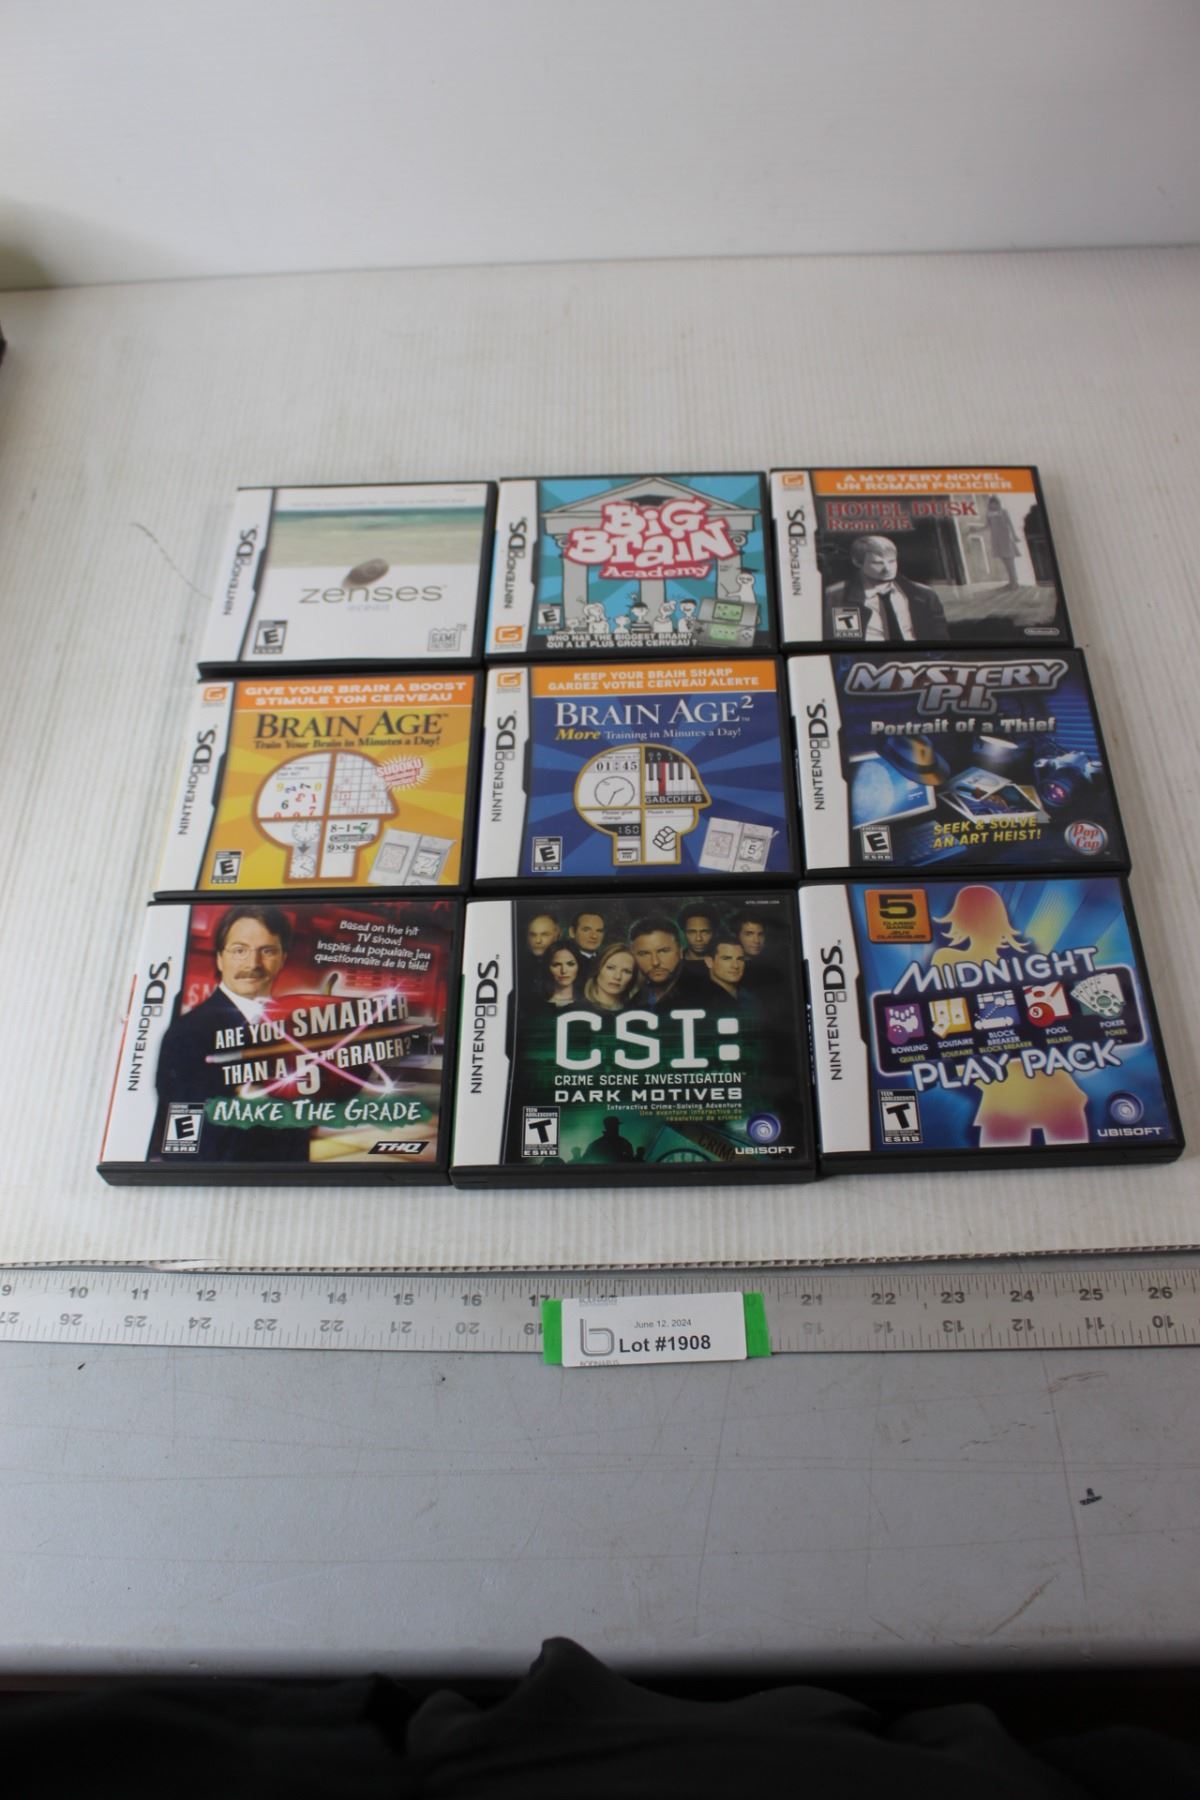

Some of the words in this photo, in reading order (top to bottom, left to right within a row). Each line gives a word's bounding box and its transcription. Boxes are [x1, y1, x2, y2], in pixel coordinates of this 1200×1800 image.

[858, 473, 941, 482] MYSTERY
[946, 473, 1003, 481] NOVEL
[866, 482, 928, 490] ROMAN
[932, 481, 1012, 489] POLICIER
[826, 501, 908, 517] HOTEL
[912, 500, 978, 516] DUSK
[787, 509, 806, 537] DS
[827, 518, 877, 530] Room
[882, 518, 912, 530] 215
[508, 521, 527, 550] DS
[604, 565, 710, 578] Academy
[298, 585, 443, 603] zenses
[658, 632, 693, 640] BRAIN?
[589, 640, 614, 648] PLUS
[646, 639, 690, 647] CERVEAU
[574, 672, 607, 681] KEEP
[611, 671, 643, 680] YOUR
[648, 669, 686, 679] BRAIN
[690, 668, 733, 677] SHARP
[851, 663, 1059, 691] MYSTERY
[245, 686, 284, 696] GIVE
[288, 685, 334, 695] YOUR
[338, 684, 390, 693] BRAIN
[393, 683, 405, 692] A
[409, 682, 466, 691] BOOST
[548, 681, 599, 691] GARDEZ
[604, 680, 643, 689] VOTRE
[647, 678, 707, 688] CERVEAU
[711, 677, 759, 686] ALERTE
[255, 696, 329, 705] STIMULE
[333, 695, 366, 704] TON
[371, 693, 452, 703] CERVEAU
[924, 685, 989, 709] P.I.
[555, 702, 661, 728] BRAIN
[807, 703, 829, 739] DS
[254, 713, 363, 739] BRAIN
[369, 709, 444, 736] AGE
[870, 718, 950, 735] Portrait
[955, 717, 976, 732] of
[982, 722, 993, 733] a
[1000, 716, 1056, 733] Thief
[495, 714, 517, 750] DS
[555, 727, 601, 741] More
[604, 730, 648, 741] Training
[663, 727, 706, 738] Minutes
[717, 727, 742, 739] Day!
[192, 729, 217, 764] DS
[254, 740, 281, 749] Train
[285, 739, 309, 749] Your
[313, 739, 341, 748] Brain
[358, 738, 402, 747] Minutes
[413, 736, 441, 748] Day!
[377, 757, 423, 777] SUDOKU
[933, 821, 971, 836] SEEK
[975, 819, 985, 831] &
[990, 815, 1037, 829] SOLVE
[1073, 823, 1099, 838] Pop
[865, 832, 889, 852] E
[932, 836, 954, 849] AN
[959, 832, 989, 846] ART
[993, 829, 1041, 842] HEIST!
[1076, 836, 1100, 850] Cap
[539, 846, 556, 862] E
[220, 859, 234, 875] E
[879, 894, 916, 919] 5
[340, 920, 370, 931] Based
[371, 924, 384, 932] on
[387, 923, 404, 935] the
[405, 926, 419, 936] hit
[358, 933, 371, 942] TV
[372, 935, 402, 945] show!
[352, 944, 366, 953] du
[367, 945, 414, 957] populaire
[314, 952, 381, 966] questionnaire
[382, 959, 395, 968] de
[820, 945, 846, 990] DS
[893, 947, 1097, 995] MIDNIGHT
[475, 960, 499, 1004] DS
[128, 1005, 152, 1091] NINTENDO
[144, 961, 170, 1005] DS
[215, 1026, 244, 1050] ARE
[249, 1019, 285, 1043] YOU
[292, 995, 409, 1037] SMARTER
[1100, 1019, 1125, 1028] POKER
[824, 991, 843, 1080] NINTENDO
[988, 1030, 1016, 1039] BLOCK
[1046, 1026, 1068, 1035] POOL
[1105, 1028, 1128, 1037] POKER
[556, 1009, 740, 1070] CSI:
[938, 1038, 974, 1048] SOLITAIRE
[987, 1036, 1020, 1046] BREAKER
[1004, 1042, 1032, 1050] BREAKER
[471, 1005, 486, 1094] NINTENDO
[891, 1044, 928, 1054] BOWLING
[941, 1049, 974, 1058] SOLITAIRE
[222, 1060, 268, 1085] THAN
[275, 1057, 288, 1078] A
[337, 1037, 412, 1068] GRADER?
[900, 1055, 926, 1063] QUILLES
[912, 1053, 1009, 1092] PLAY
[1022, 1039, 1122, 1078] PACK
[555, 1074, 594, 1086] CRIME
[600, 1074, 639, 1086] SCENE
[645, 1072, 742, 1085] INVESTIGATION
[554, 1089, 621, 1103] DARK
[631, 1087, 742, 1101] MOTIVES
[213, 1101, 284, 1122] MAKE
[293, 1099, 337, 1121] THE
[345, 1098, 422, 1122] GRADE
[886, 1102, 911, 1129] T
[175, 1115, 195, 1140] E
[528, 1119, 553, 1144] T
[1097, 1127, 1163, 1137] UBISOFT
[378, 1143, 422, 1153] THQ
[735, 1146, 796, 1155] UBISOFT
[1, 1284, 12, 1296] 9
[69, 1286, 88, 1298] 10
[131, 1288, 149, 1300] 11
[196, 1289, 217, 1301] 12
[1010, 1290, 1034, 1302] 24
[1079, 1288, 1104, 1301] 25
[1148, 1286, 1173, 1299] 26
[261, 1291, 281, 1303] 13
[327, 1292, 348, 1304] 14
[393, 1293, 414, 1306] 15
[461, 1294, 482, 1306] 16
[801, 1294, 823, 1306] 21
[871, 1293, 896, 1305] 22
[941, 1291, 965, 1304] 23
[60, 1313, 83, 1326] 26
[124, 1315, 148, 1328] 25
[188, 1316, 212, 1329] 24
[254, 1318, 278, 1331] 23
[320, 1319, 345, 1332] 22
[634, 1320, 654, 1329] June
[671, 1318, 692, 1327] 2024
[1084, 1317, 1104, 1330] 11
[391, 1321, 413, 1333] 21
[455, 1322, 480, 1335] 20
[619, 1338, 650, 1353] Lot
[655, 1335, 711, 1351] #1908
